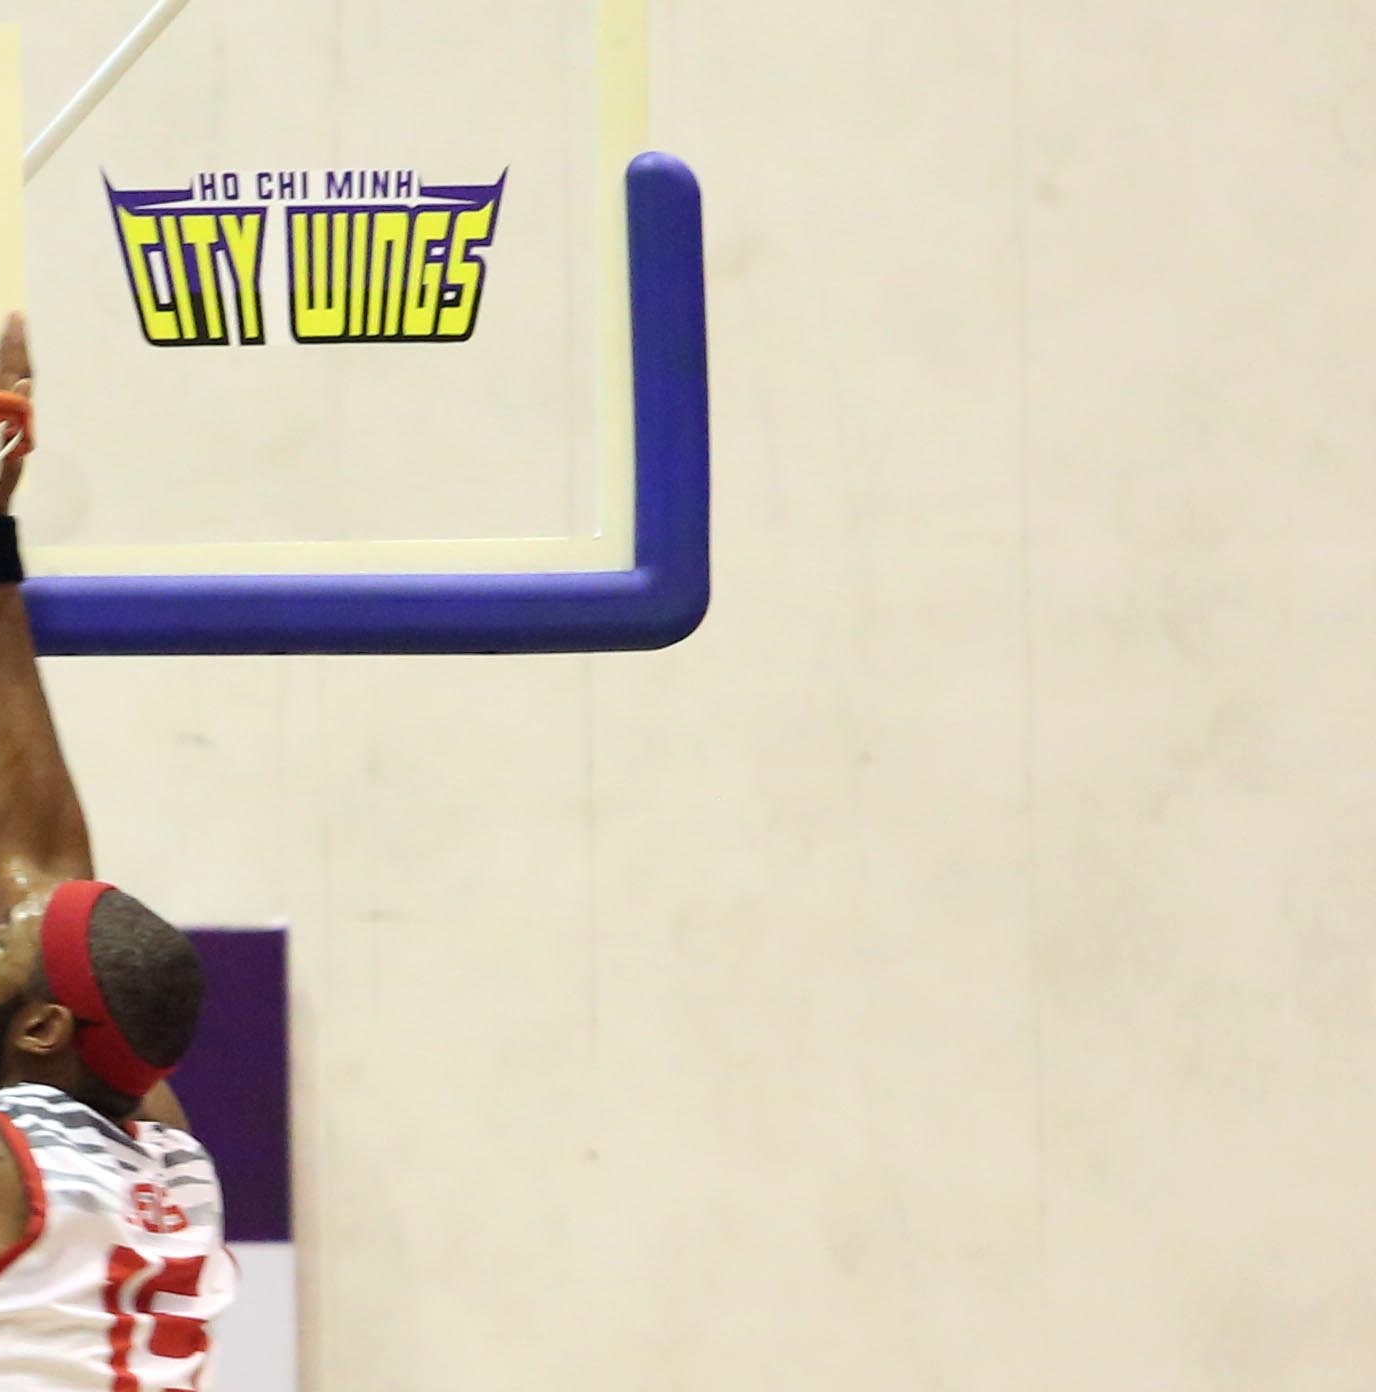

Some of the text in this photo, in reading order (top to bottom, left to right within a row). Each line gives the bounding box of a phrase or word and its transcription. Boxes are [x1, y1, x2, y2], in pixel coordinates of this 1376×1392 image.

[199, 169, 413, 200] HO CHI MINH
[114, 200, 494, 344] CITY WINGS
